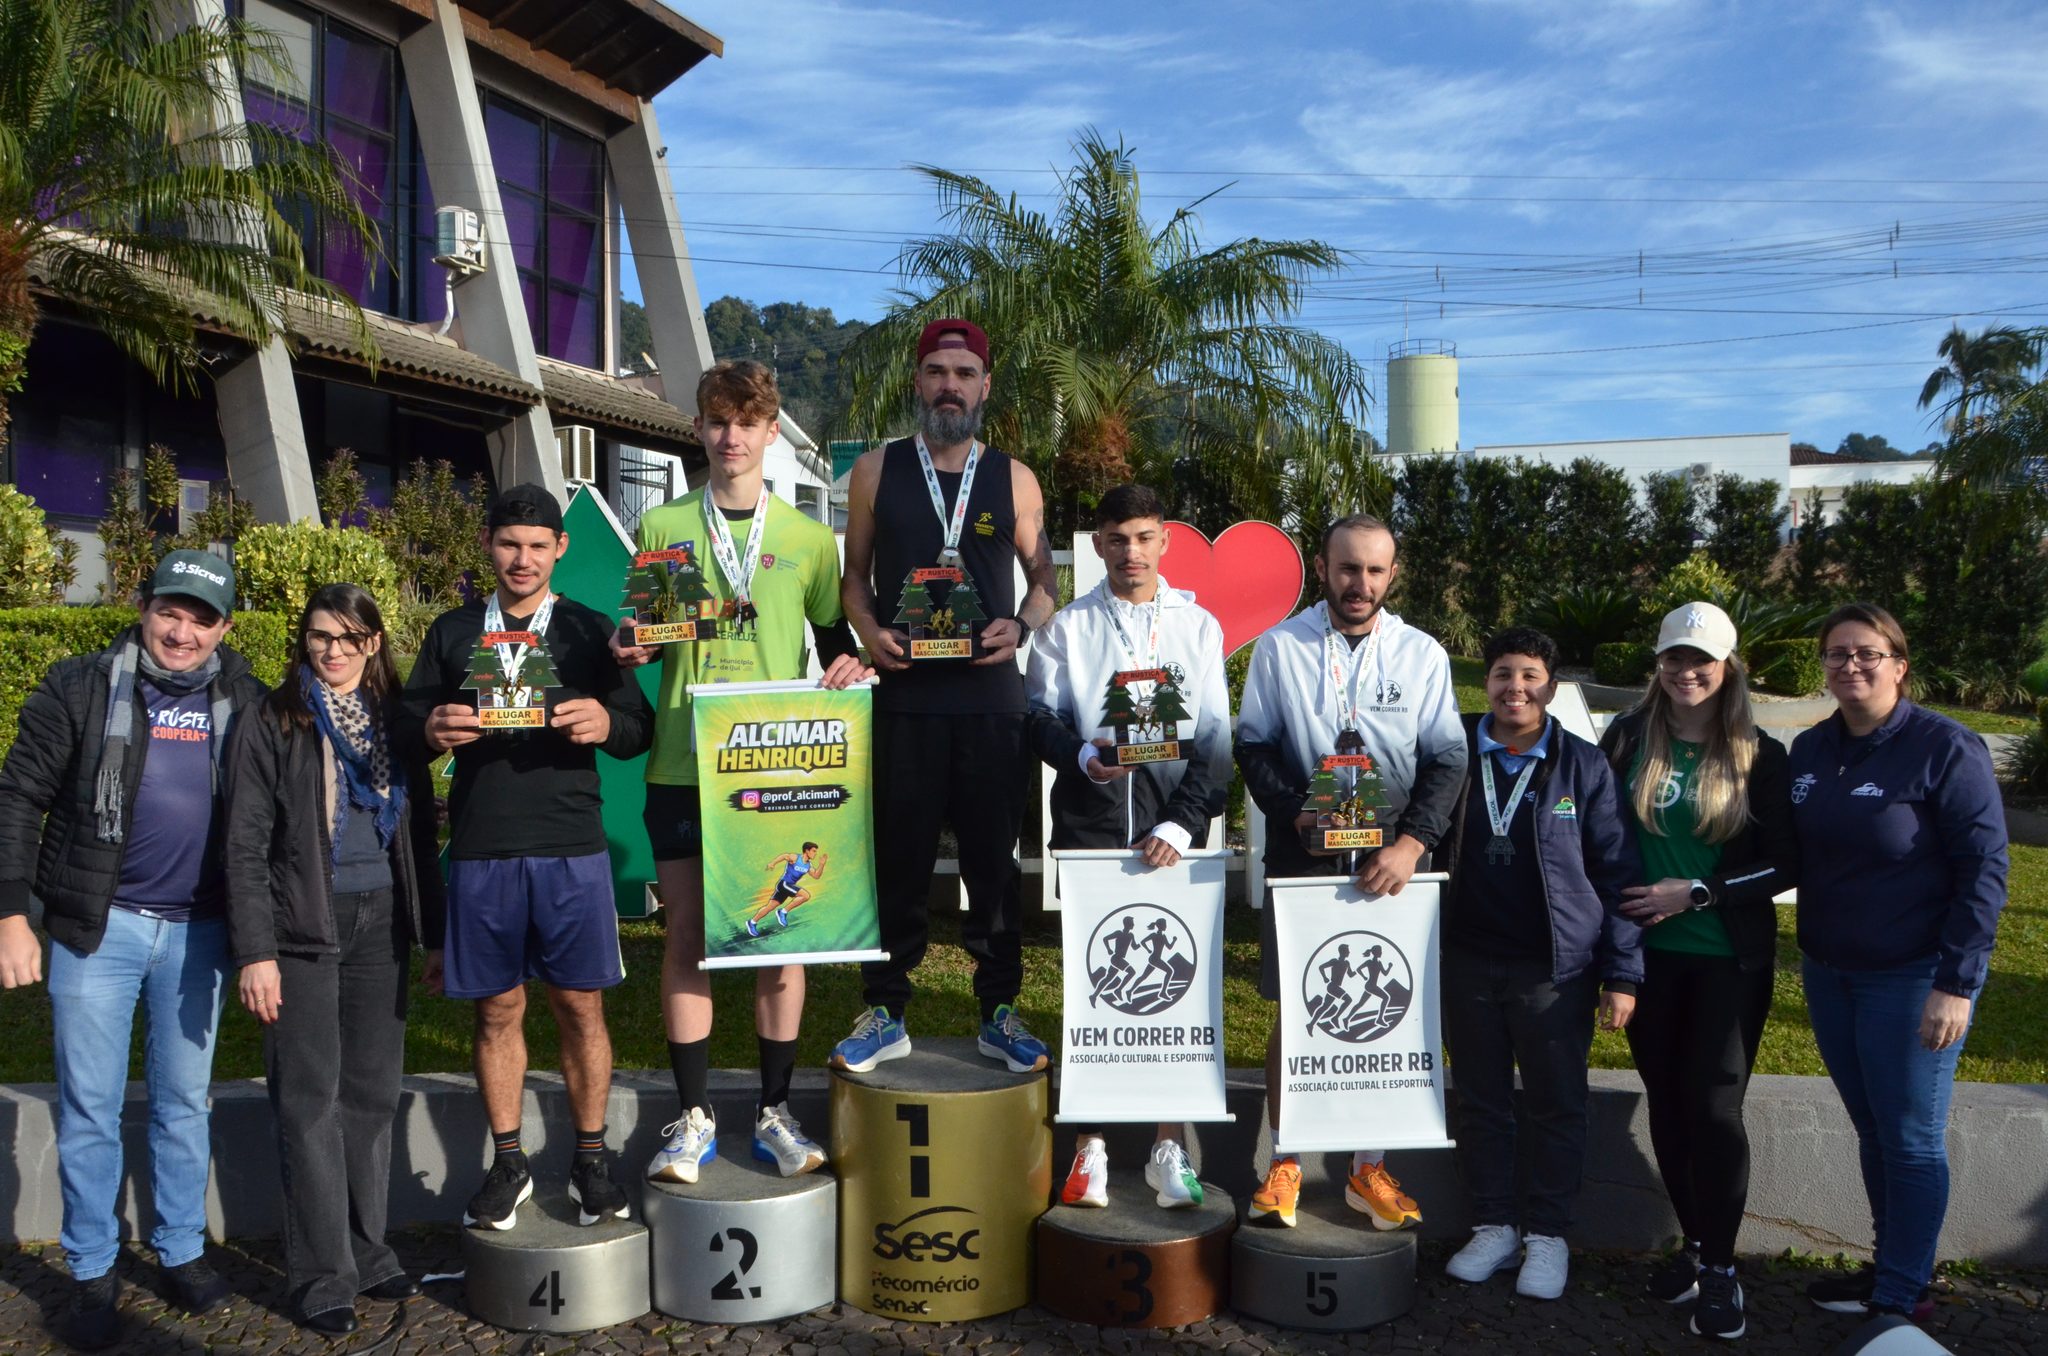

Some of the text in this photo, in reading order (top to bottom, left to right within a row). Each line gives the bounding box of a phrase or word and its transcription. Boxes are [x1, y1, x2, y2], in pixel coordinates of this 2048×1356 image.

[186, 563, 227, 587] Sicredi
[638, 633, 674, 643] MASCULINO
[651, 625, 683, 635] LUGAR
[157, 706, 210, 731] RÚSTI
[497, 710, 531, 719] LUGAR
[728, 720, 844, 748] ALCIMAR
[720, 744, 844, 771] HENRIQUE
[1121, 754, 1156, 763] MASCULINO
[1134, 745, 1167, 755] LUGAR
[761, 789, 840, 804] @prof_alcimarh
[1341, 831, 1371, 840] LUGAR
[1070, 1026, 1215, 1047] VEM CORRER RB
[1069, 1052, 1215, 1065] ASSOCIAÇÃO CULTURAL E ESPORTIVA
[1288, 1051, 1434, 1076] VEM CORRER RB
[1288, 1078, 1434, 1094] ASSOCIAÇÃO CULTURAL E ESPORTIVA
[896, 1103, 931, 1198] 1
[872, 1212, 981, 1263] Sesc
[708, 1227, 762, 1300] 2
[528, 1270, 566, 1316] 4
[1104, 1250, 1154, 1323] 3
[1306, 1271, 1338, 1317] 5
[872, 1294, 929, 1315] Senac
